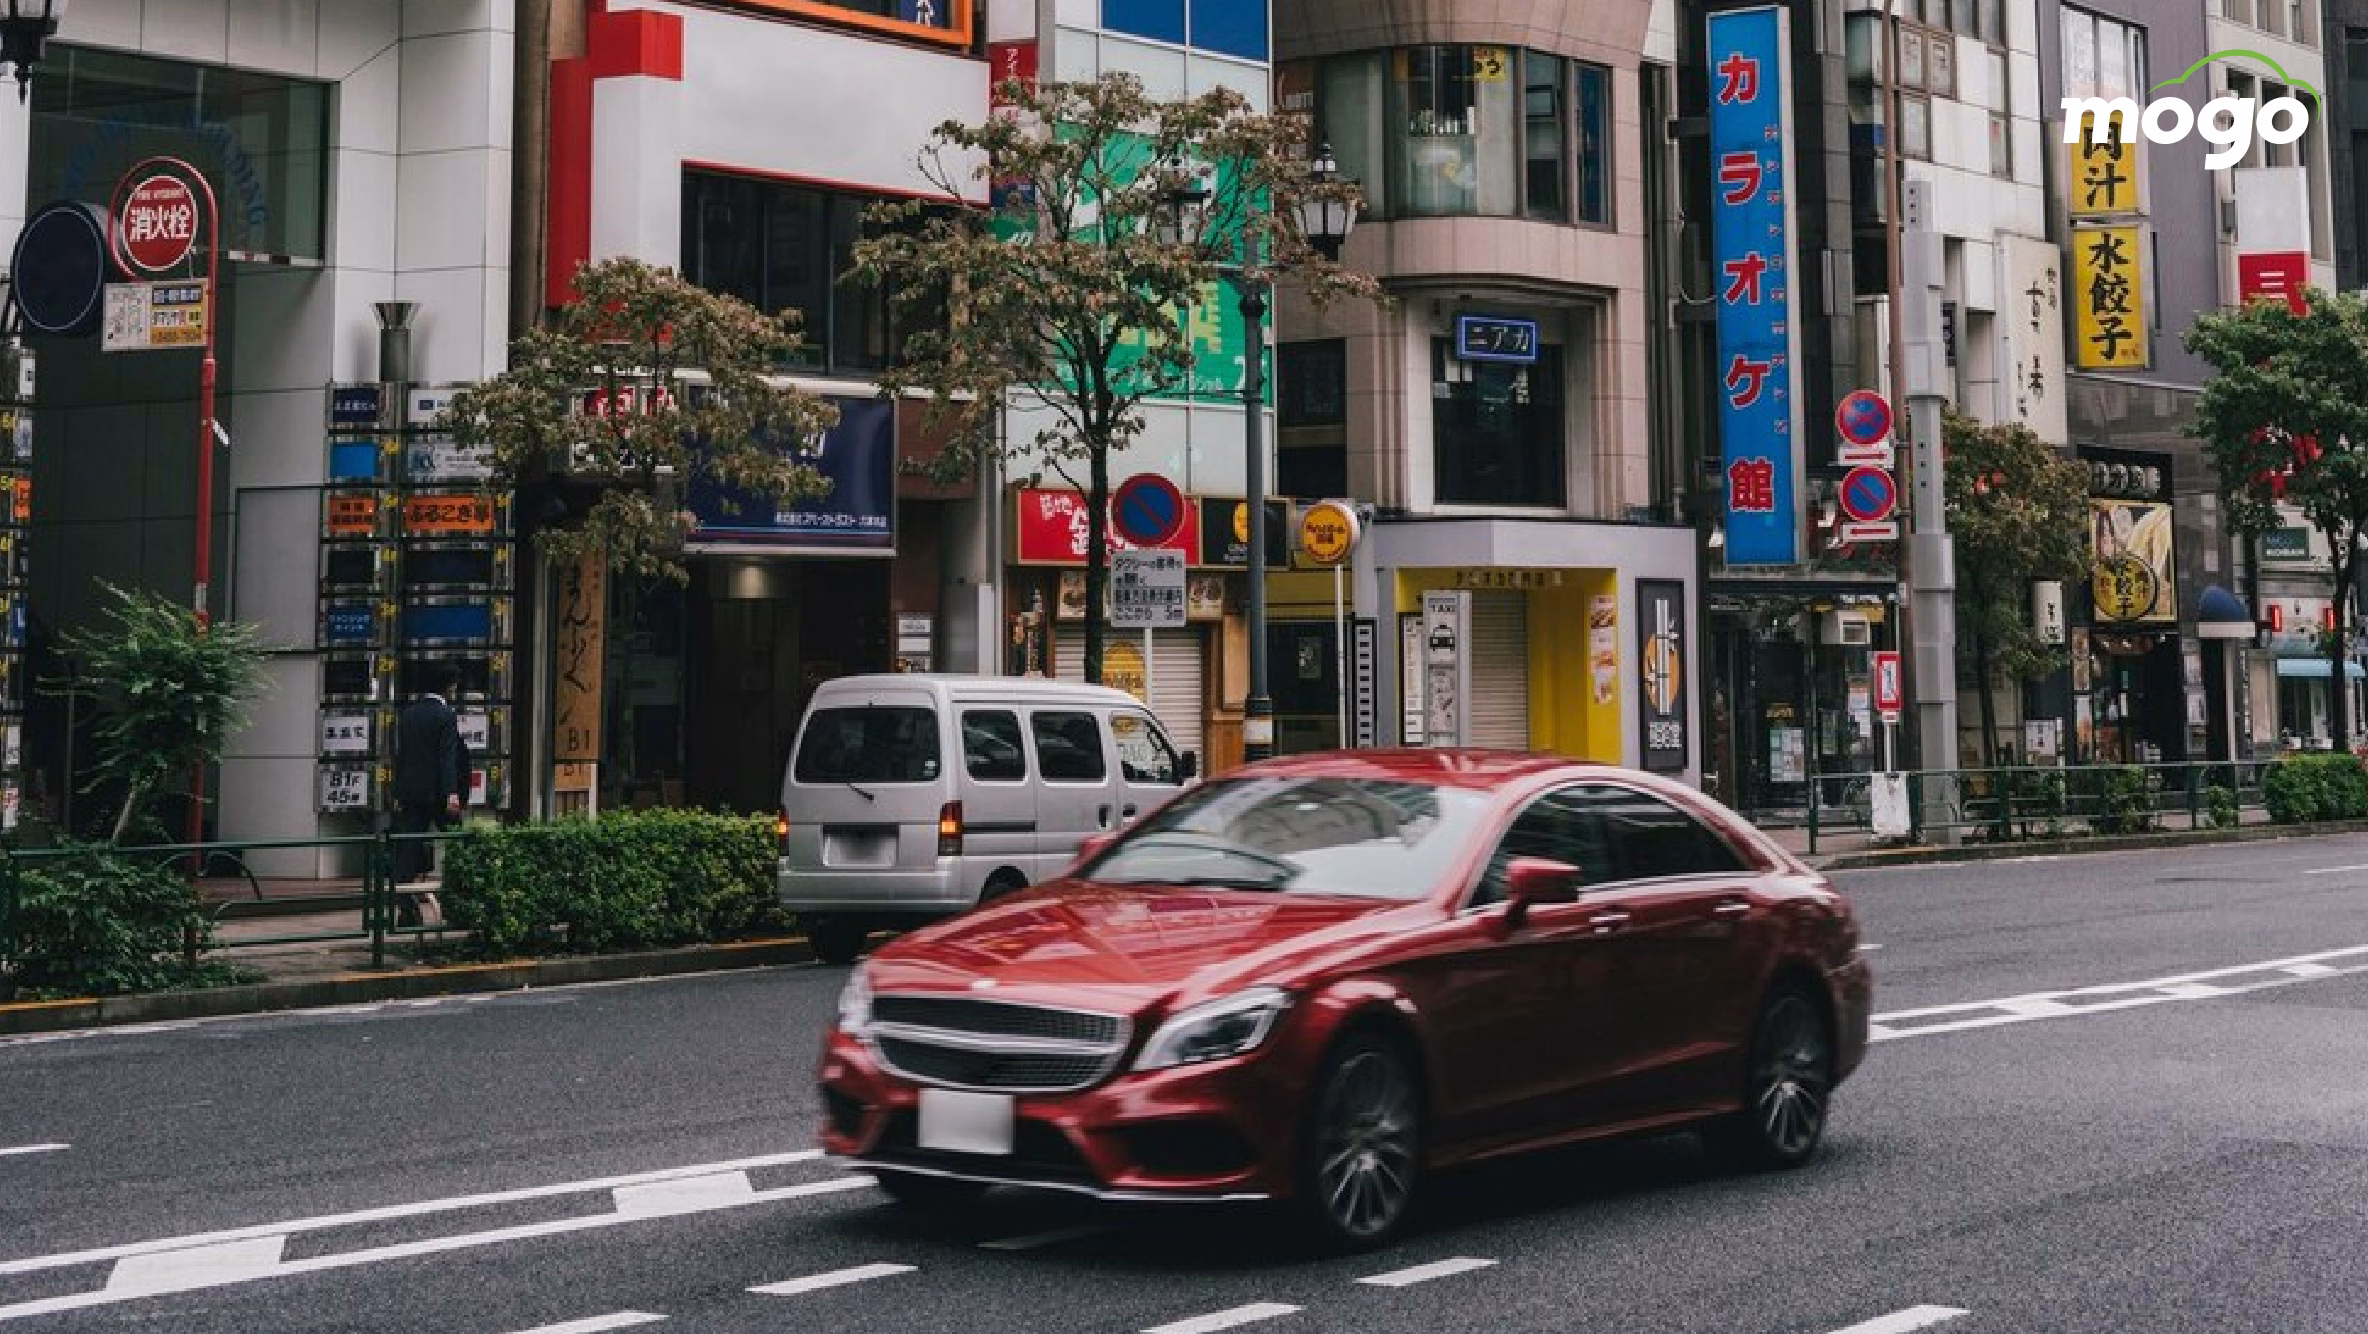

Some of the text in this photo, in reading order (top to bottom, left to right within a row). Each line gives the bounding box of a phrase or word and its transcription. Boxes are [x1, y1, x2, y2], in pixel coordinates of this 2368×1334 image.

[129, 203, 192, 243] 消火栓
[1717, 50, 1776, 514] カラオケ館
[2088, 231, 2133, 361] 水餃子
